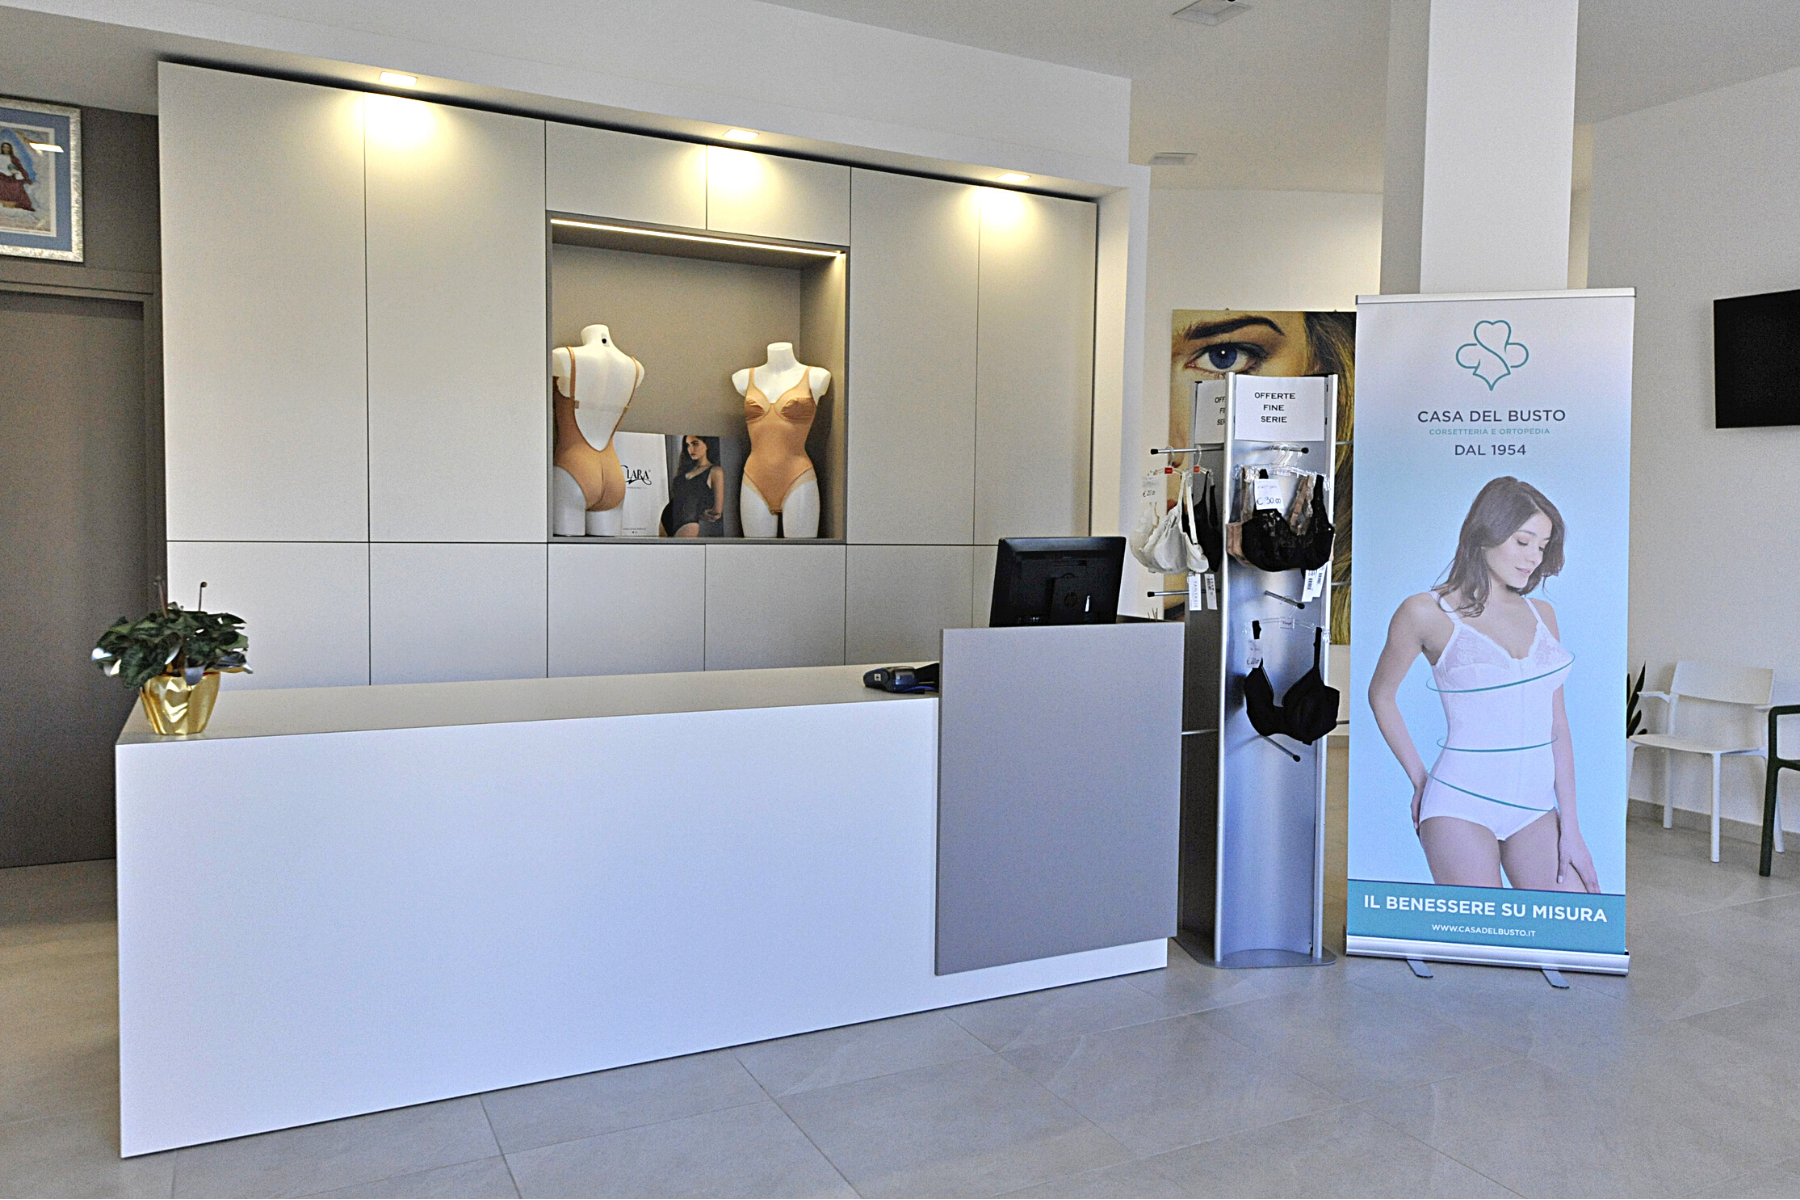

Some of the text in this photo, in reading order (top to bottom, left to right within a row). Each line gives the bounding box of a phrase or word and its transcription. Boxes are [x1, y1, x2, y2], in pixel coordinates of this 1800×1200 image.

[1254, 391, 1296, 400] OFFERTE
[1263, 404, 1285, 412] FINE
[1260, 415, 1288, 424] SERIE
[1417, 409, 1566, 423] CASA DEL BUSTO
[1429, 428, 1489, 436] CORSETTERIA
[1499, 427, 1551, 436] ORTOPEDIA
[1454, 444, 1527, 456] DAL 1954
[1364, 894, 1608, 923] IL BENESSERE SU MISURA
[1431, 923, 1536, 938] WWW.CASADELBUSTO.IT
